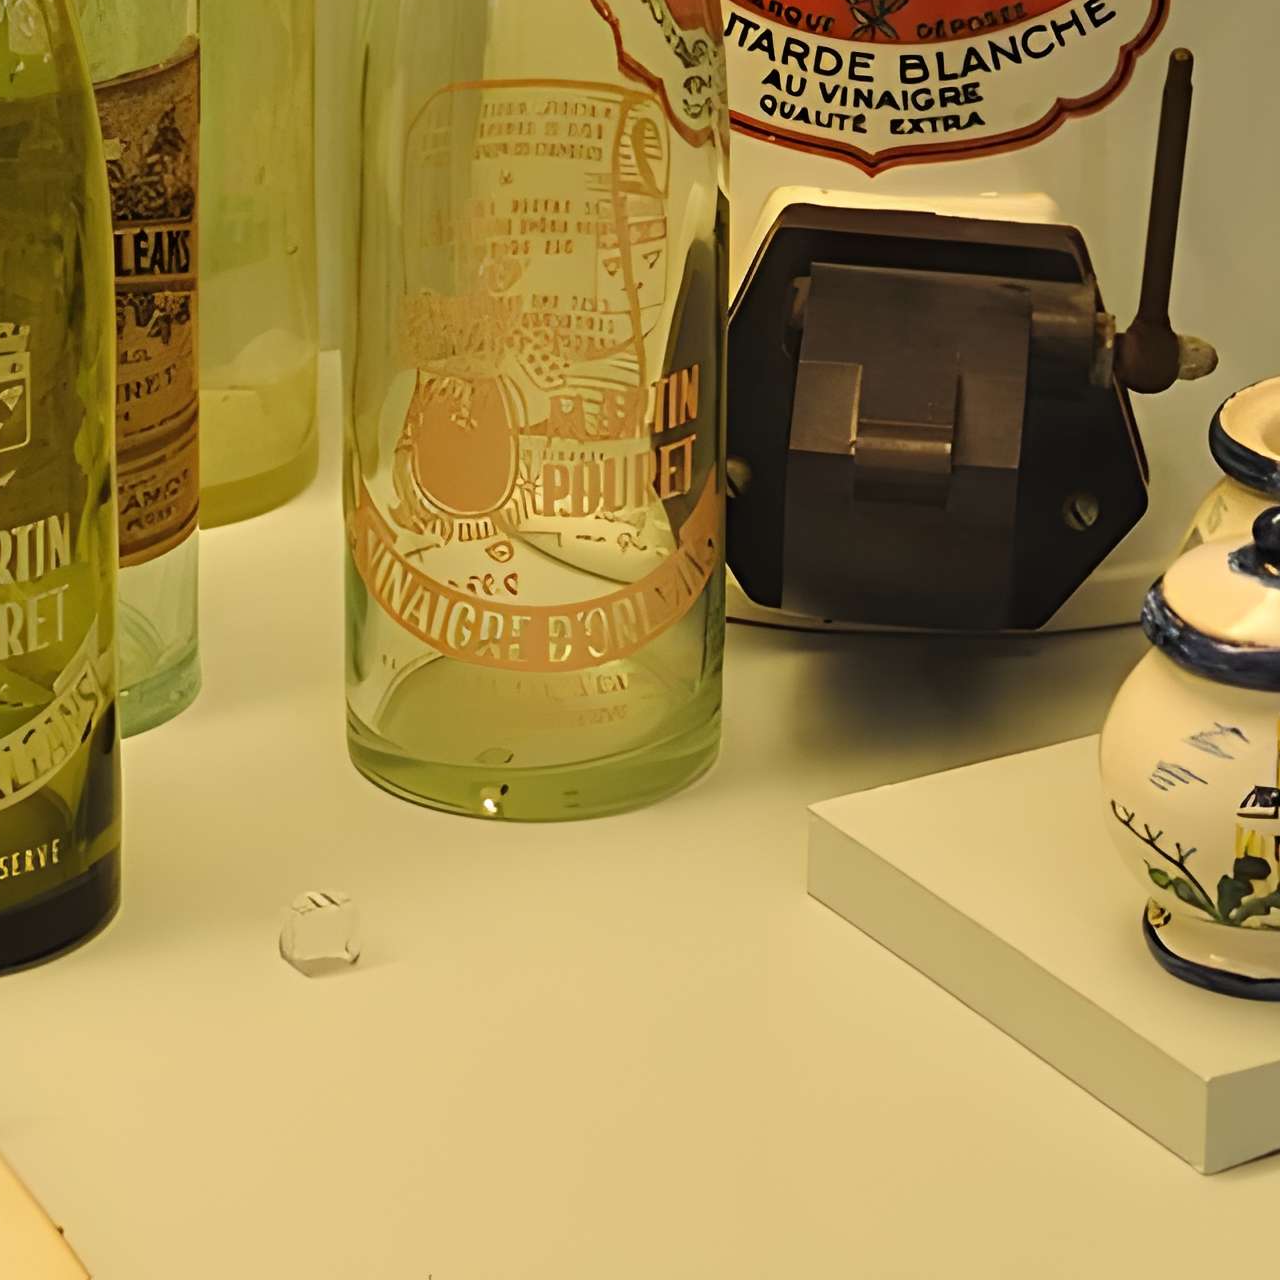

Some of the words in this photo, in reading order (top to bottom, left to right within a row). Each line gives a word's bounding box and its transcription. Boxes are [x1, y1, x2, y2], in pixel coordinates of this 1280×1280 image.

[761, 68, 808, 98] AU
[818, 81, 984, 113] VINAIGRE
[889, 110, 987, 135] EXTRA
[365, 526, 532, 662] VINAIGRE
